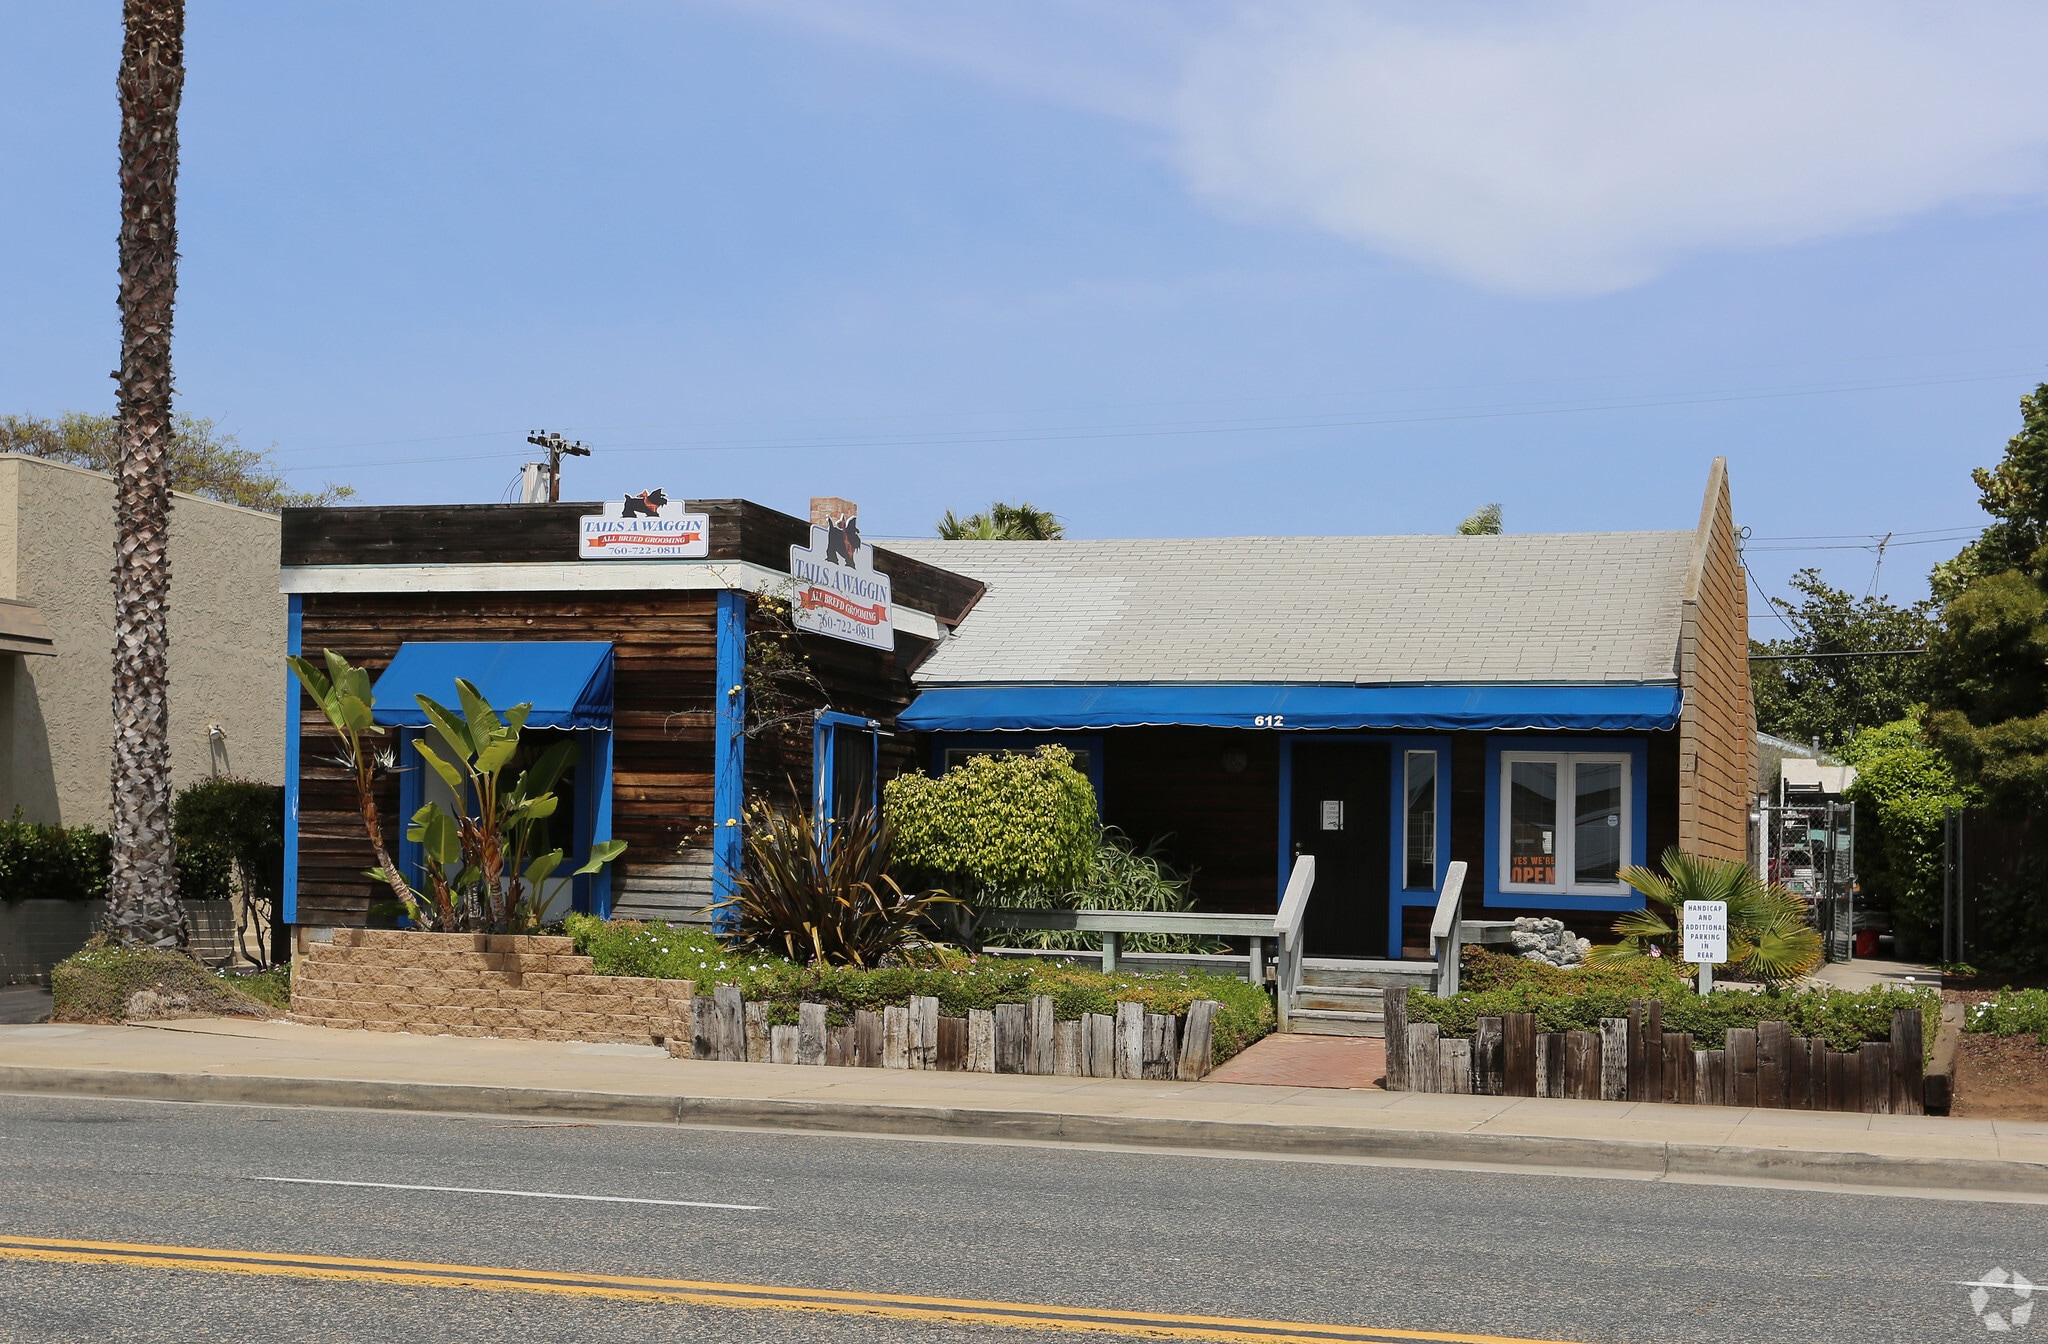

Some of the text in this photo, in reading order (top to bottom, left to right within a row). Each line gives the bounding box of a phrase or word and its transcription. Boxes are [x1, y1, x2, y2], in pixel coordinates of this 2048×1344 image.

[584, 520, 704, 532] TAILS A WAGGIN
[601, 535, 685, 544] ALL BREED GROOMING
[608, 546, 681, 555] 760-722-0811
[795, 558, 888, 603] TAILS A WAGGIN
[811, 590, 877, 622] ALL BREED GROOMING
[1254, 715, 1284, 727] 612
[1512, 856, 1555, 865] YES WE'RE
[1511, 866, 1556, 884] OPEN
[1685, 923, 1726, 931] ADDITIONAL
[1690, 933, 1721, 941] PARKING
